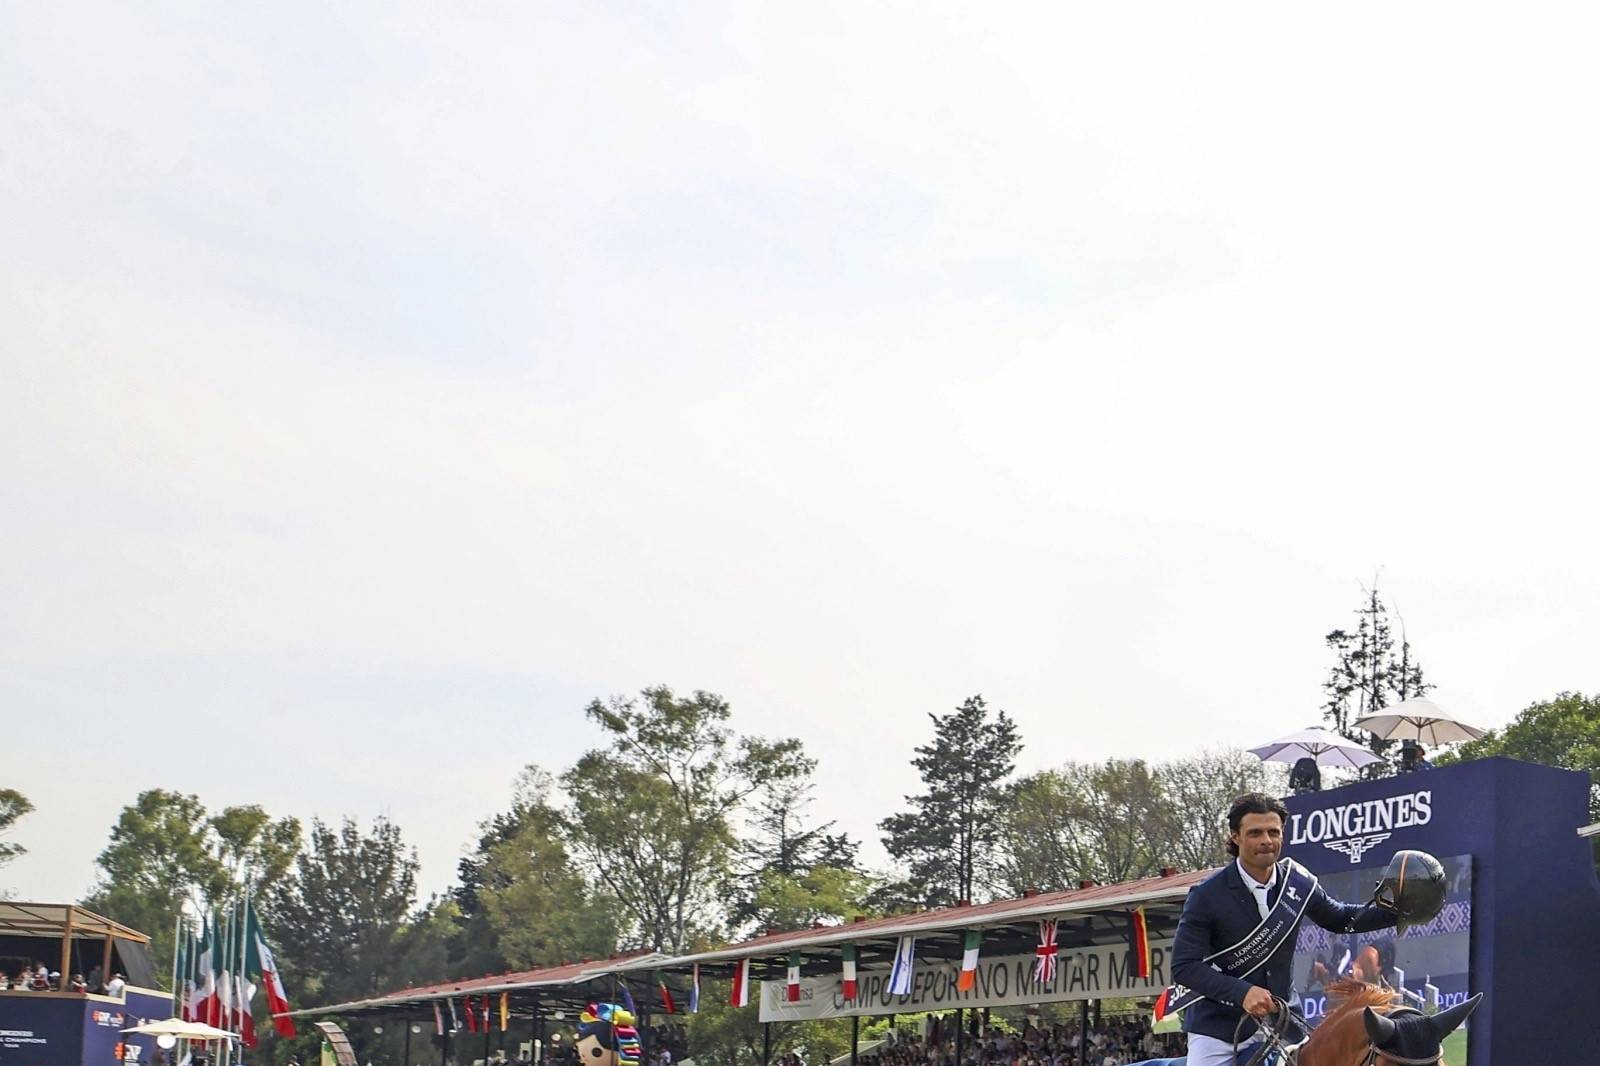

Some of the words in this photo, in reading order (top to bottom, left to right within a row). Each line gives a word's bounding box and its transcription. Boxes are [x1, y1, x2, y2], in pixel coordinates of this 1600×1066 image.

[1290, 791, 1431, 844] LONGINES
[1227, 954, 1252, 970] GLOBAL
[1252, 920, 1284, 955] CHAMPIONS
[1234, 927, 1270, 957] LONGINES
